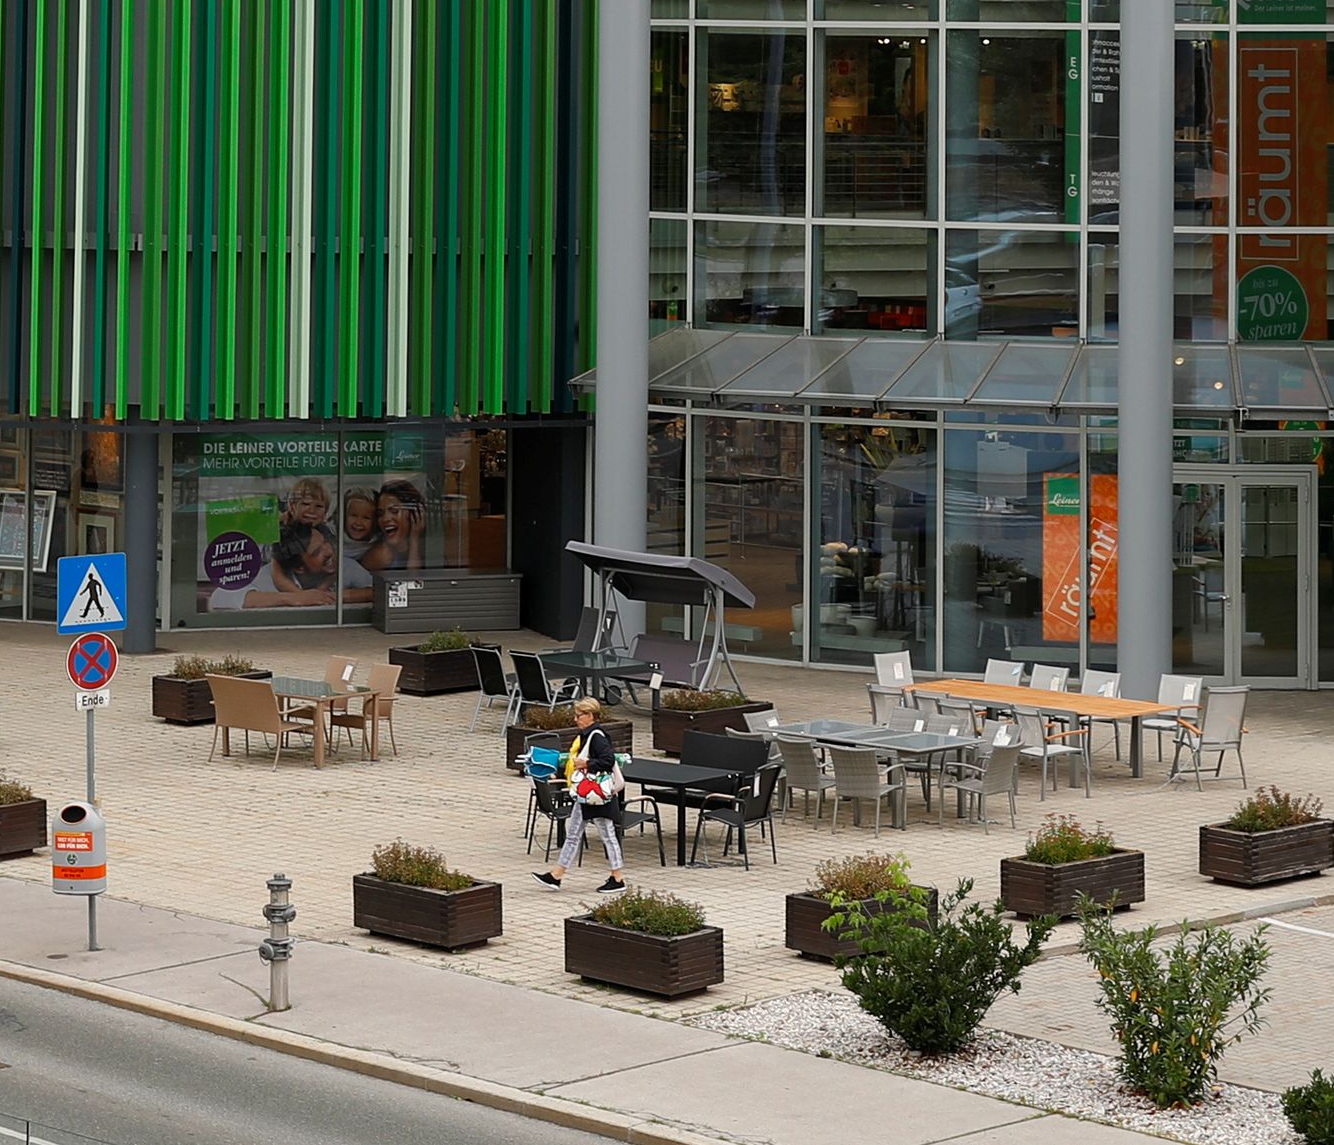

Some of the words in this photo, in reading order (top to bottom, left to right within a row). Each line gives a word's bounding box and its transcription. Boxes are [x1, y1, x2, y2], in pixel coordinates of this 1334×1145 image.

[1247, 63, 1292, 247] räumt
[1252, 278, 1265, 289] bis
[1267, 278, 1278, 288] zu
[1240, 290, 1298, 321] -70%
[1248, 322, 1297, 341] sparen
[203, 442, 225, 455] DIE
[229, 441, 273, 454] LEINER
[202, 456, 240, 470] MEHR
[241, 455, 299, 469] VORTEILE
[302, 454, 325, 468] FÜR
[212, 539, 248, 559] JETZT
[211, 553, 253, 567] anmelden
[224, 562, 242, 574] und
[218, 570, 251, 585] sparen!
[82, 693, 104, 707] Ende
